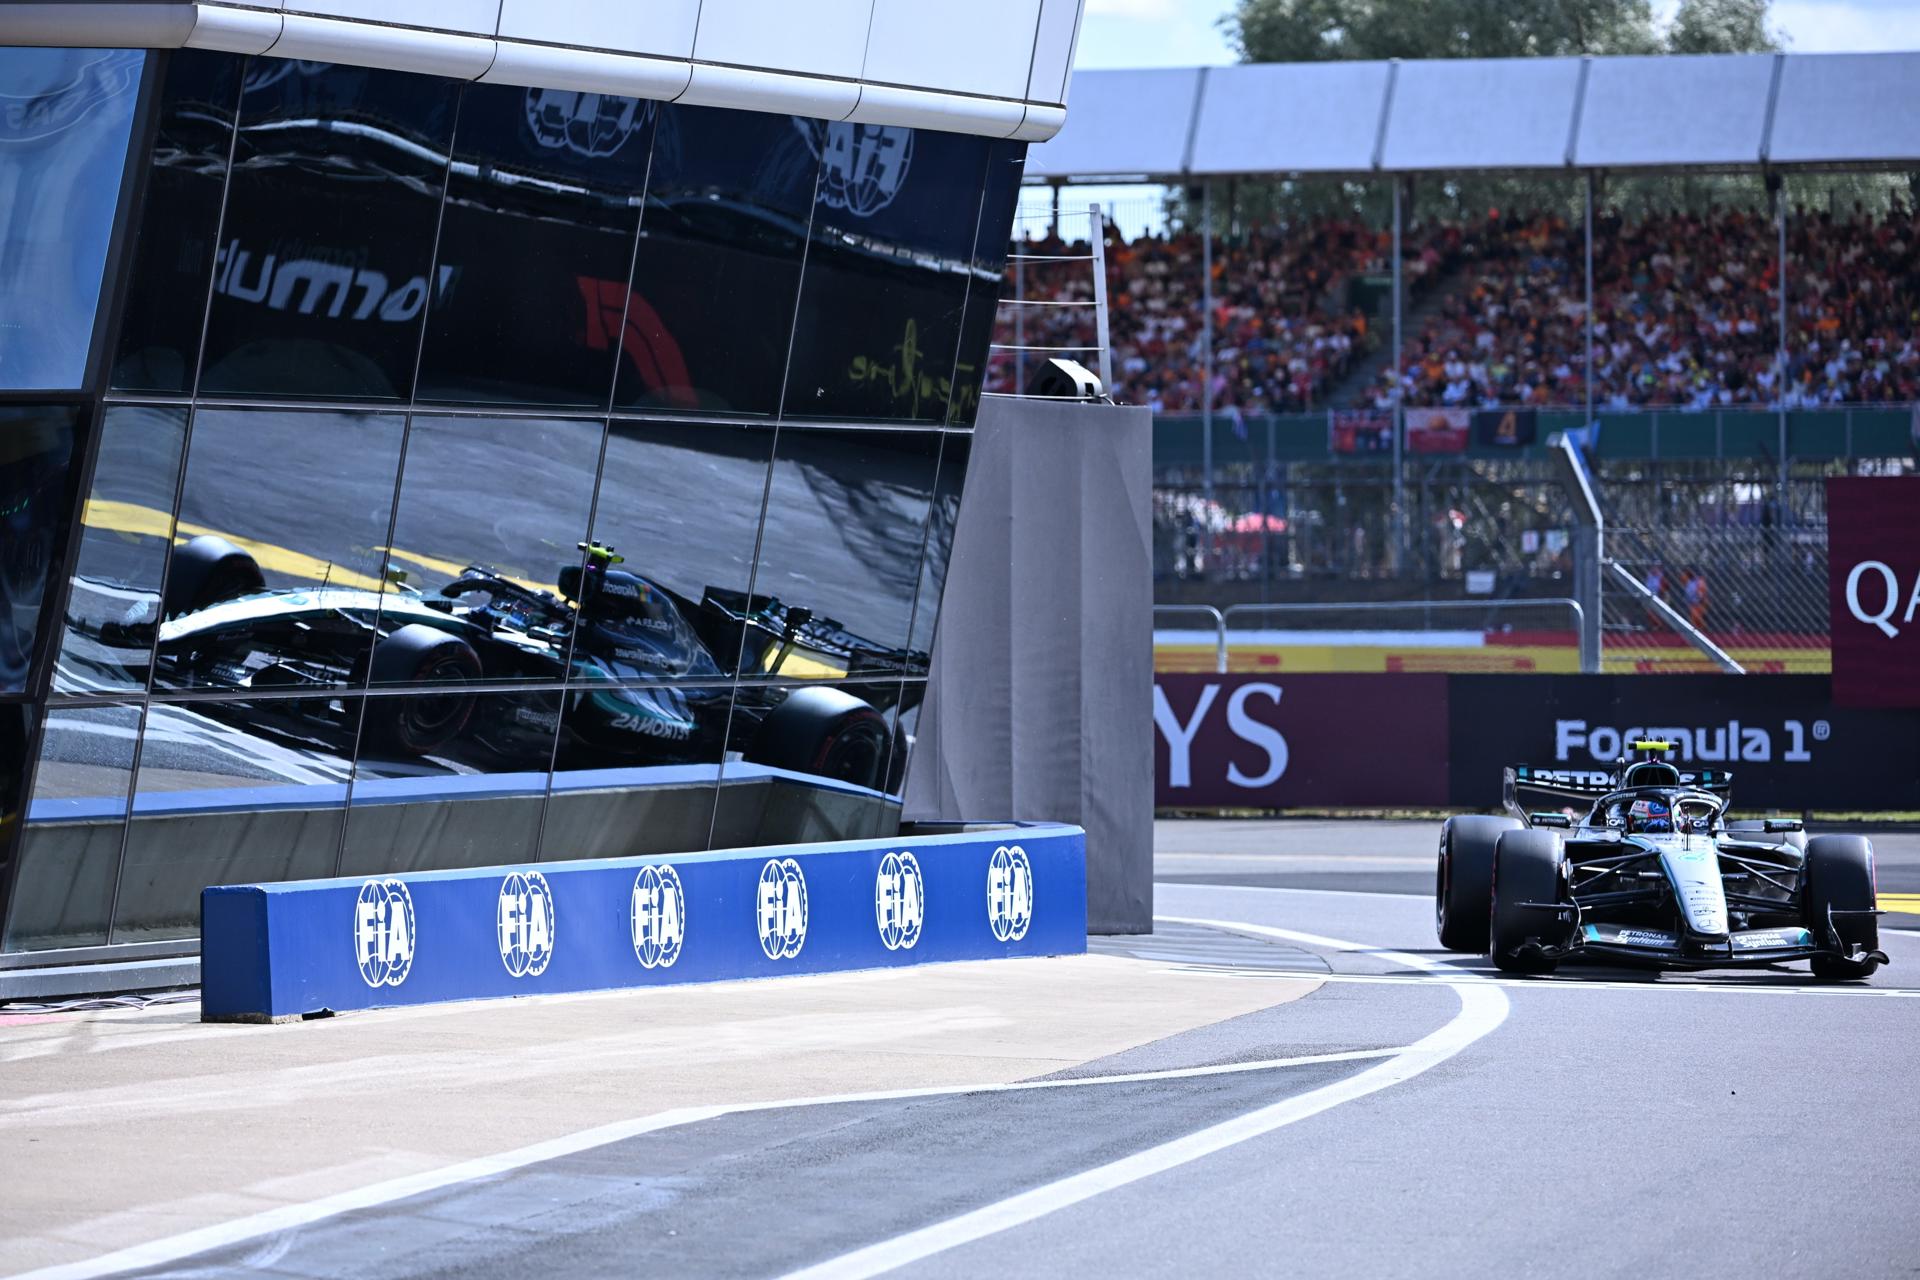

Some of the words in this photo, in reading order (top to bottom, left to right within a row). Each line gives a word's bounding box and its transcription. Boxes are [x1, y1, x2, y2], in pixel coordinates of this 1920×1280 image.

[1152, 682, 1290, 788] YS
[1555, 719, 1771, 761] Formula
[1533, 769, 1697, 791] PETRS
